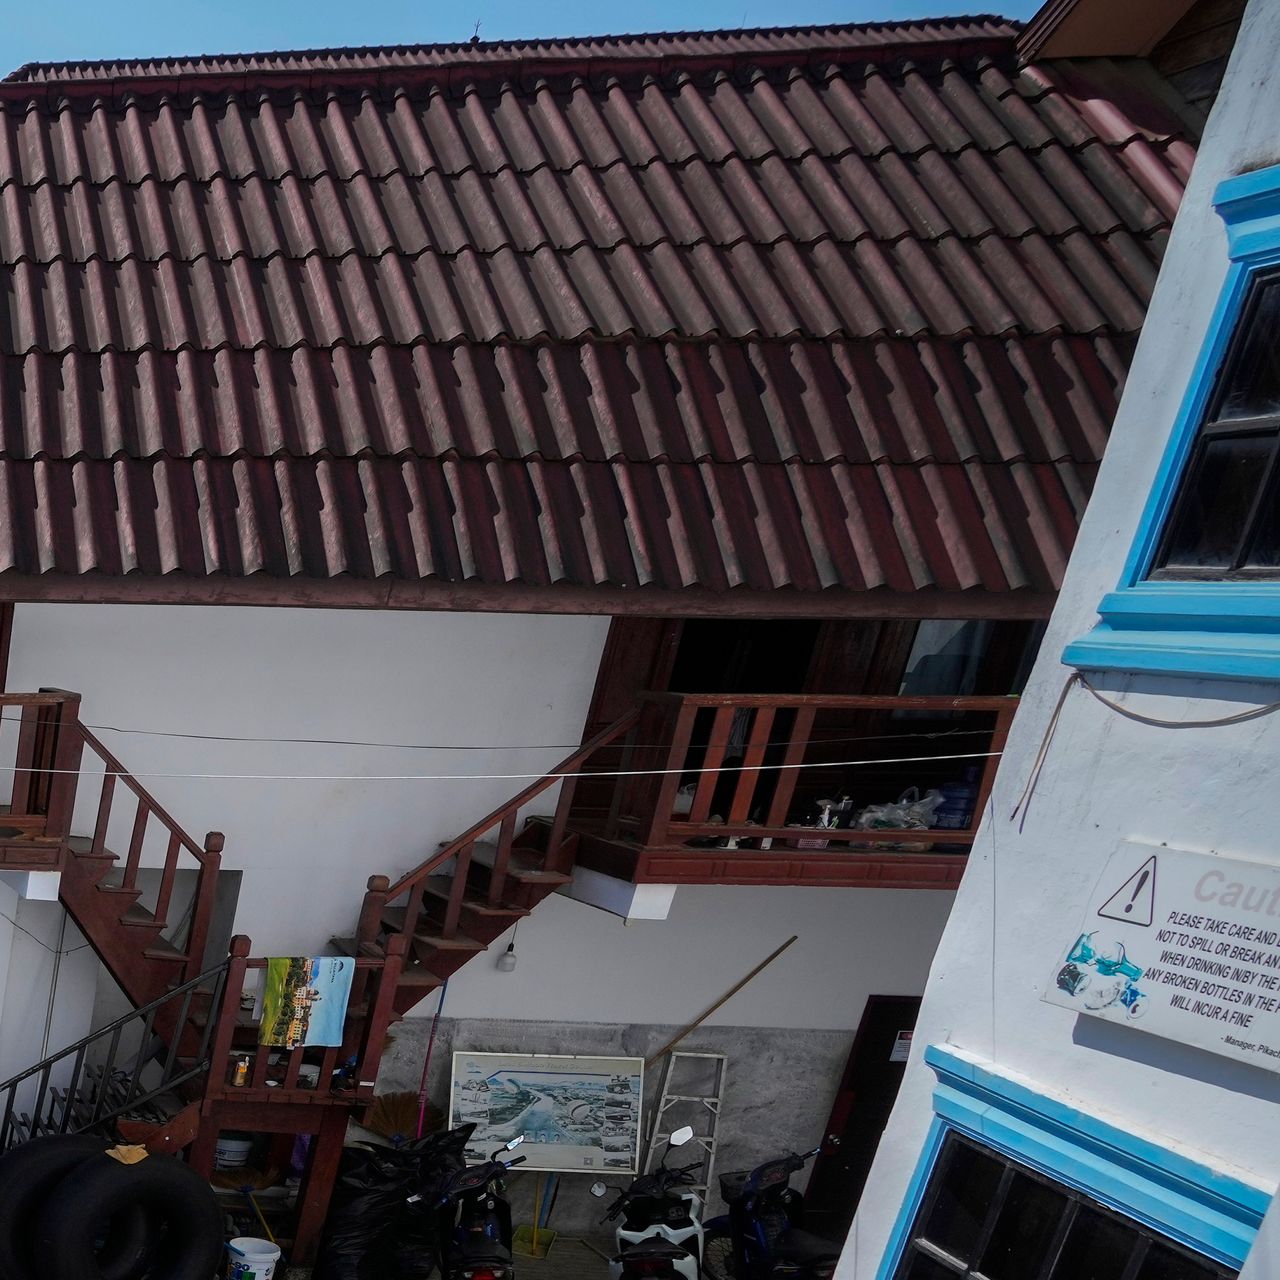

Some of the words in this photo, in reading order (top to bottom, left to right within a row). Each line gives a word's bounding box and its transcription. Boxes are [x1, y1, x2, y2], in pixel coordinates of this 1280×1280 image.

[1166, 911, 1204, 930] PLEASE
[1203, 919, 1228, 936] TAKE
[1228, 924, 1255, 942] CARE
[1255, 930, 1276, 947] AND
[1155, 929, 1175, 947] NOT
[1173, 932, 1187, 948] TO
[1187, 935, 1214, 955] SPILL
[1214, 942, 1231, 957] OR
[1231, 945, 1266, 966] BREAK
[1159, 949, 1187, 967] WHEN
[1186, 955, 1230, 978] DRINKING
[1231, 964, 1260, 985] IN/BY
[1259, 971, 1278, 989] THE
[1142, 967, 1164, 984] ANY
[1163, 971, 1200, 993] BROKEN
[1200, 980, 1244, 1004] BOTTLES
[1243, 991, 1255, 1006] IN
[1254, 994, 1275, 1012] THE
[1169, 994, 1192, 1011] WILL
[1192, 999, 1222, 1018] INCUR
[1220, 1007, 1231, 1020] A
[1230, 1009, 1254, 1028] FINE
[1224, 1034, 1256, 1052] Manager,
